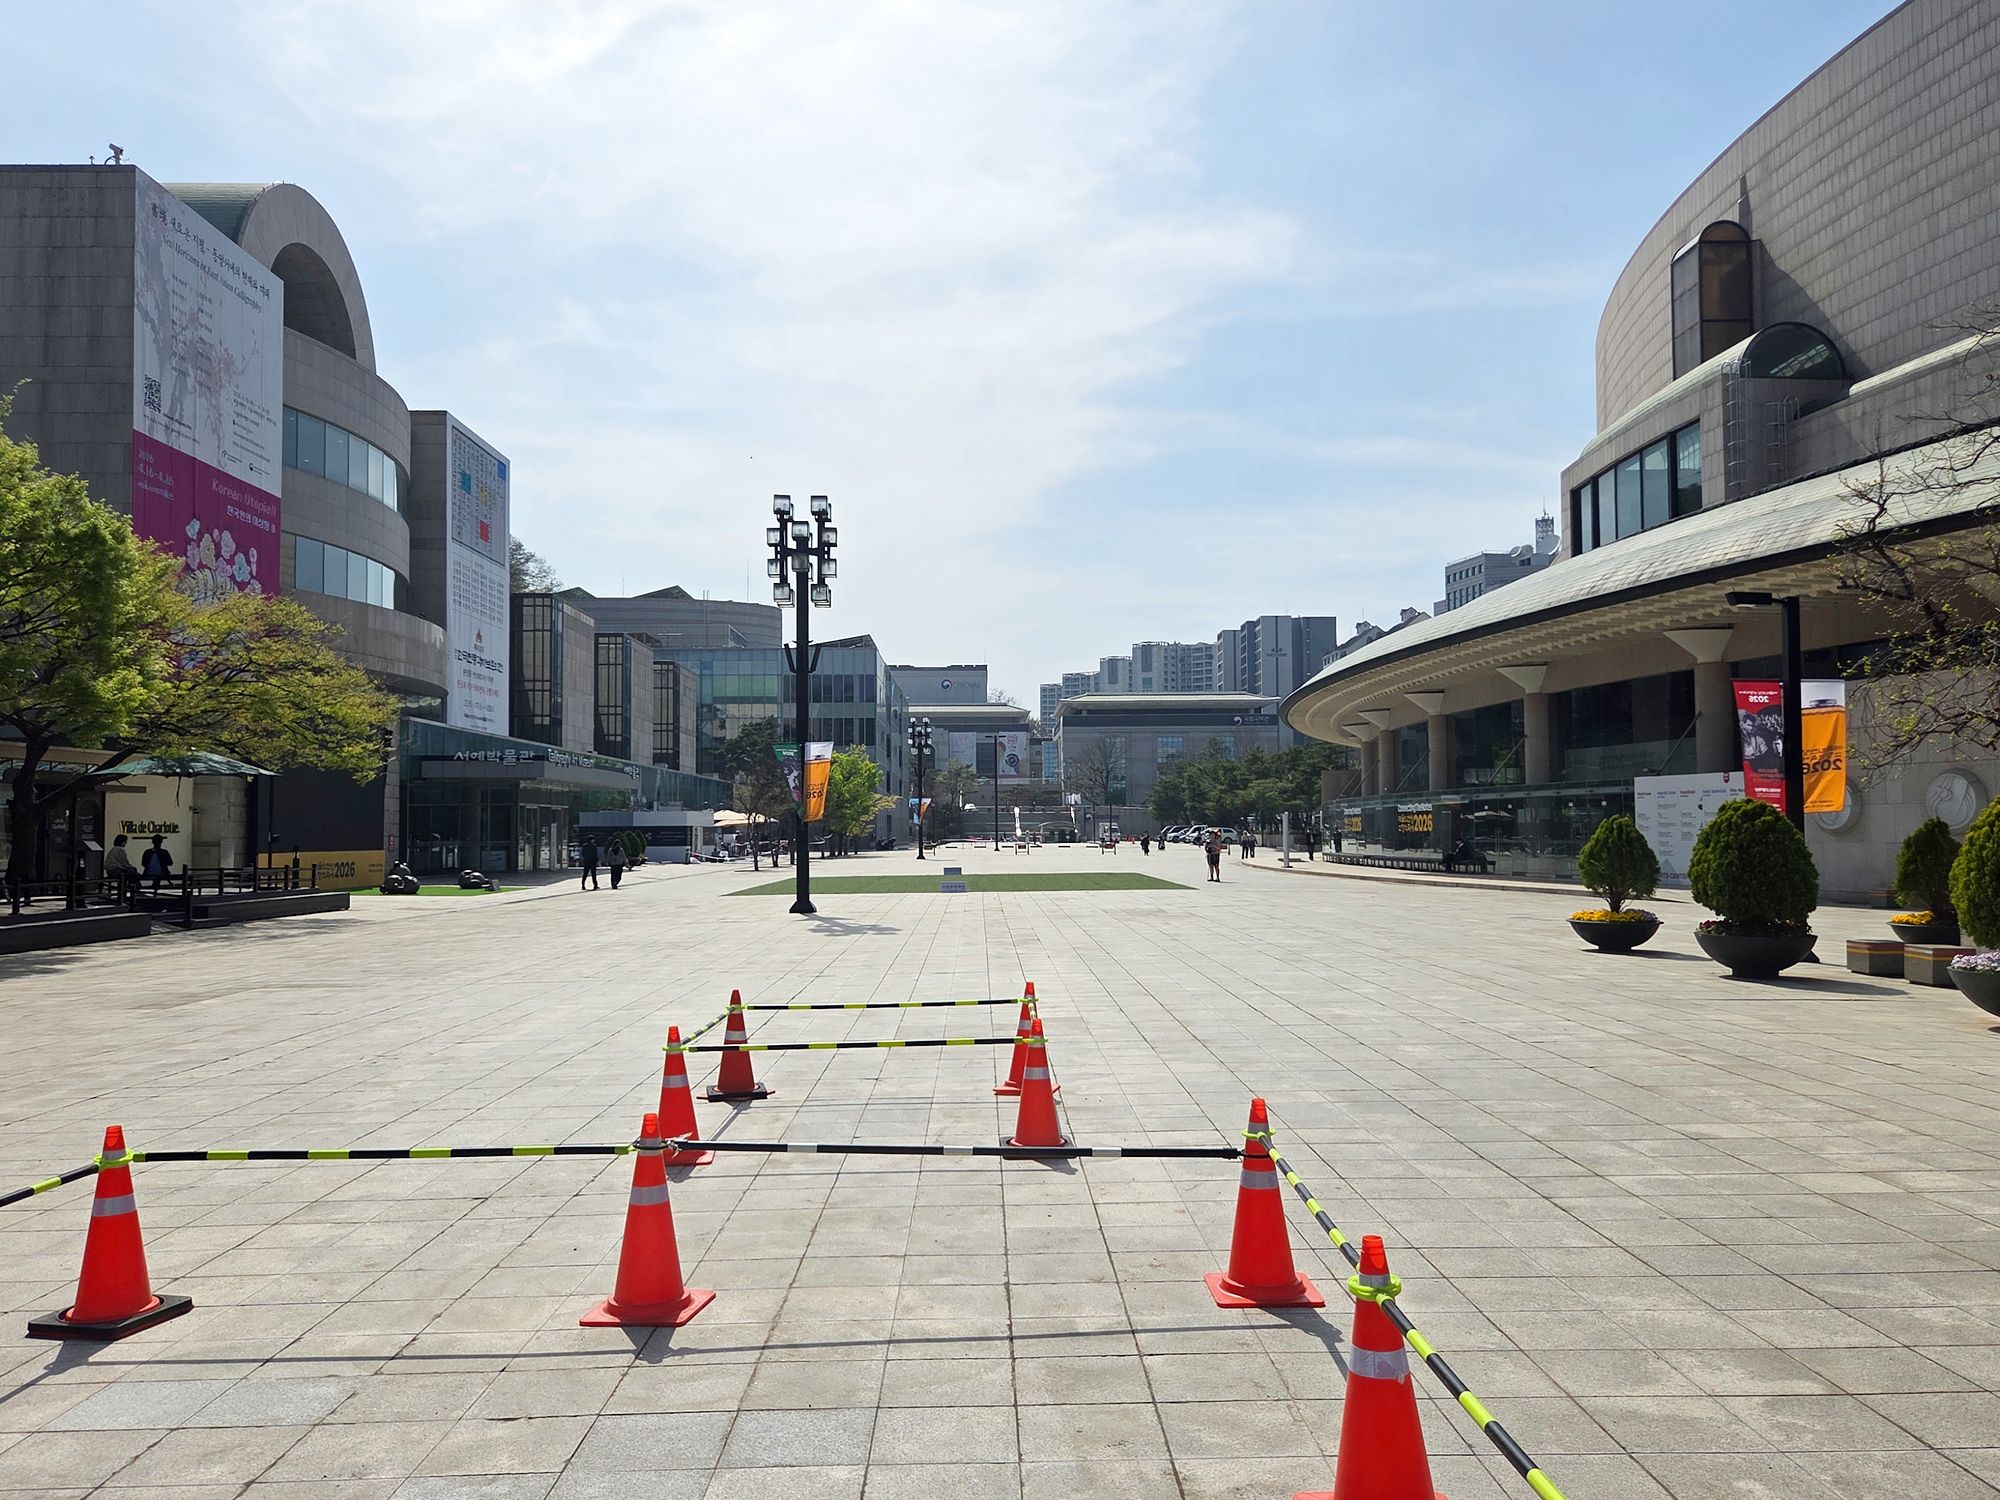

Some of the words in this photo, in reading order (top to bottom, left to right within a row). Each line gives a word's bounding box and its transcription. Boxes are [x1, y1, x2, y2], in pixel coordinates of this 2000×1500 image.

[211, 478, 243, 502] Korean
[453, 748, 536, 766] 서예박물관
[119, 820, 137, 833] Villa
[138, 820, 147, 833] de
[1413, 814, 1433, 832] 2026
[335, 861, 355, 878] 2026
